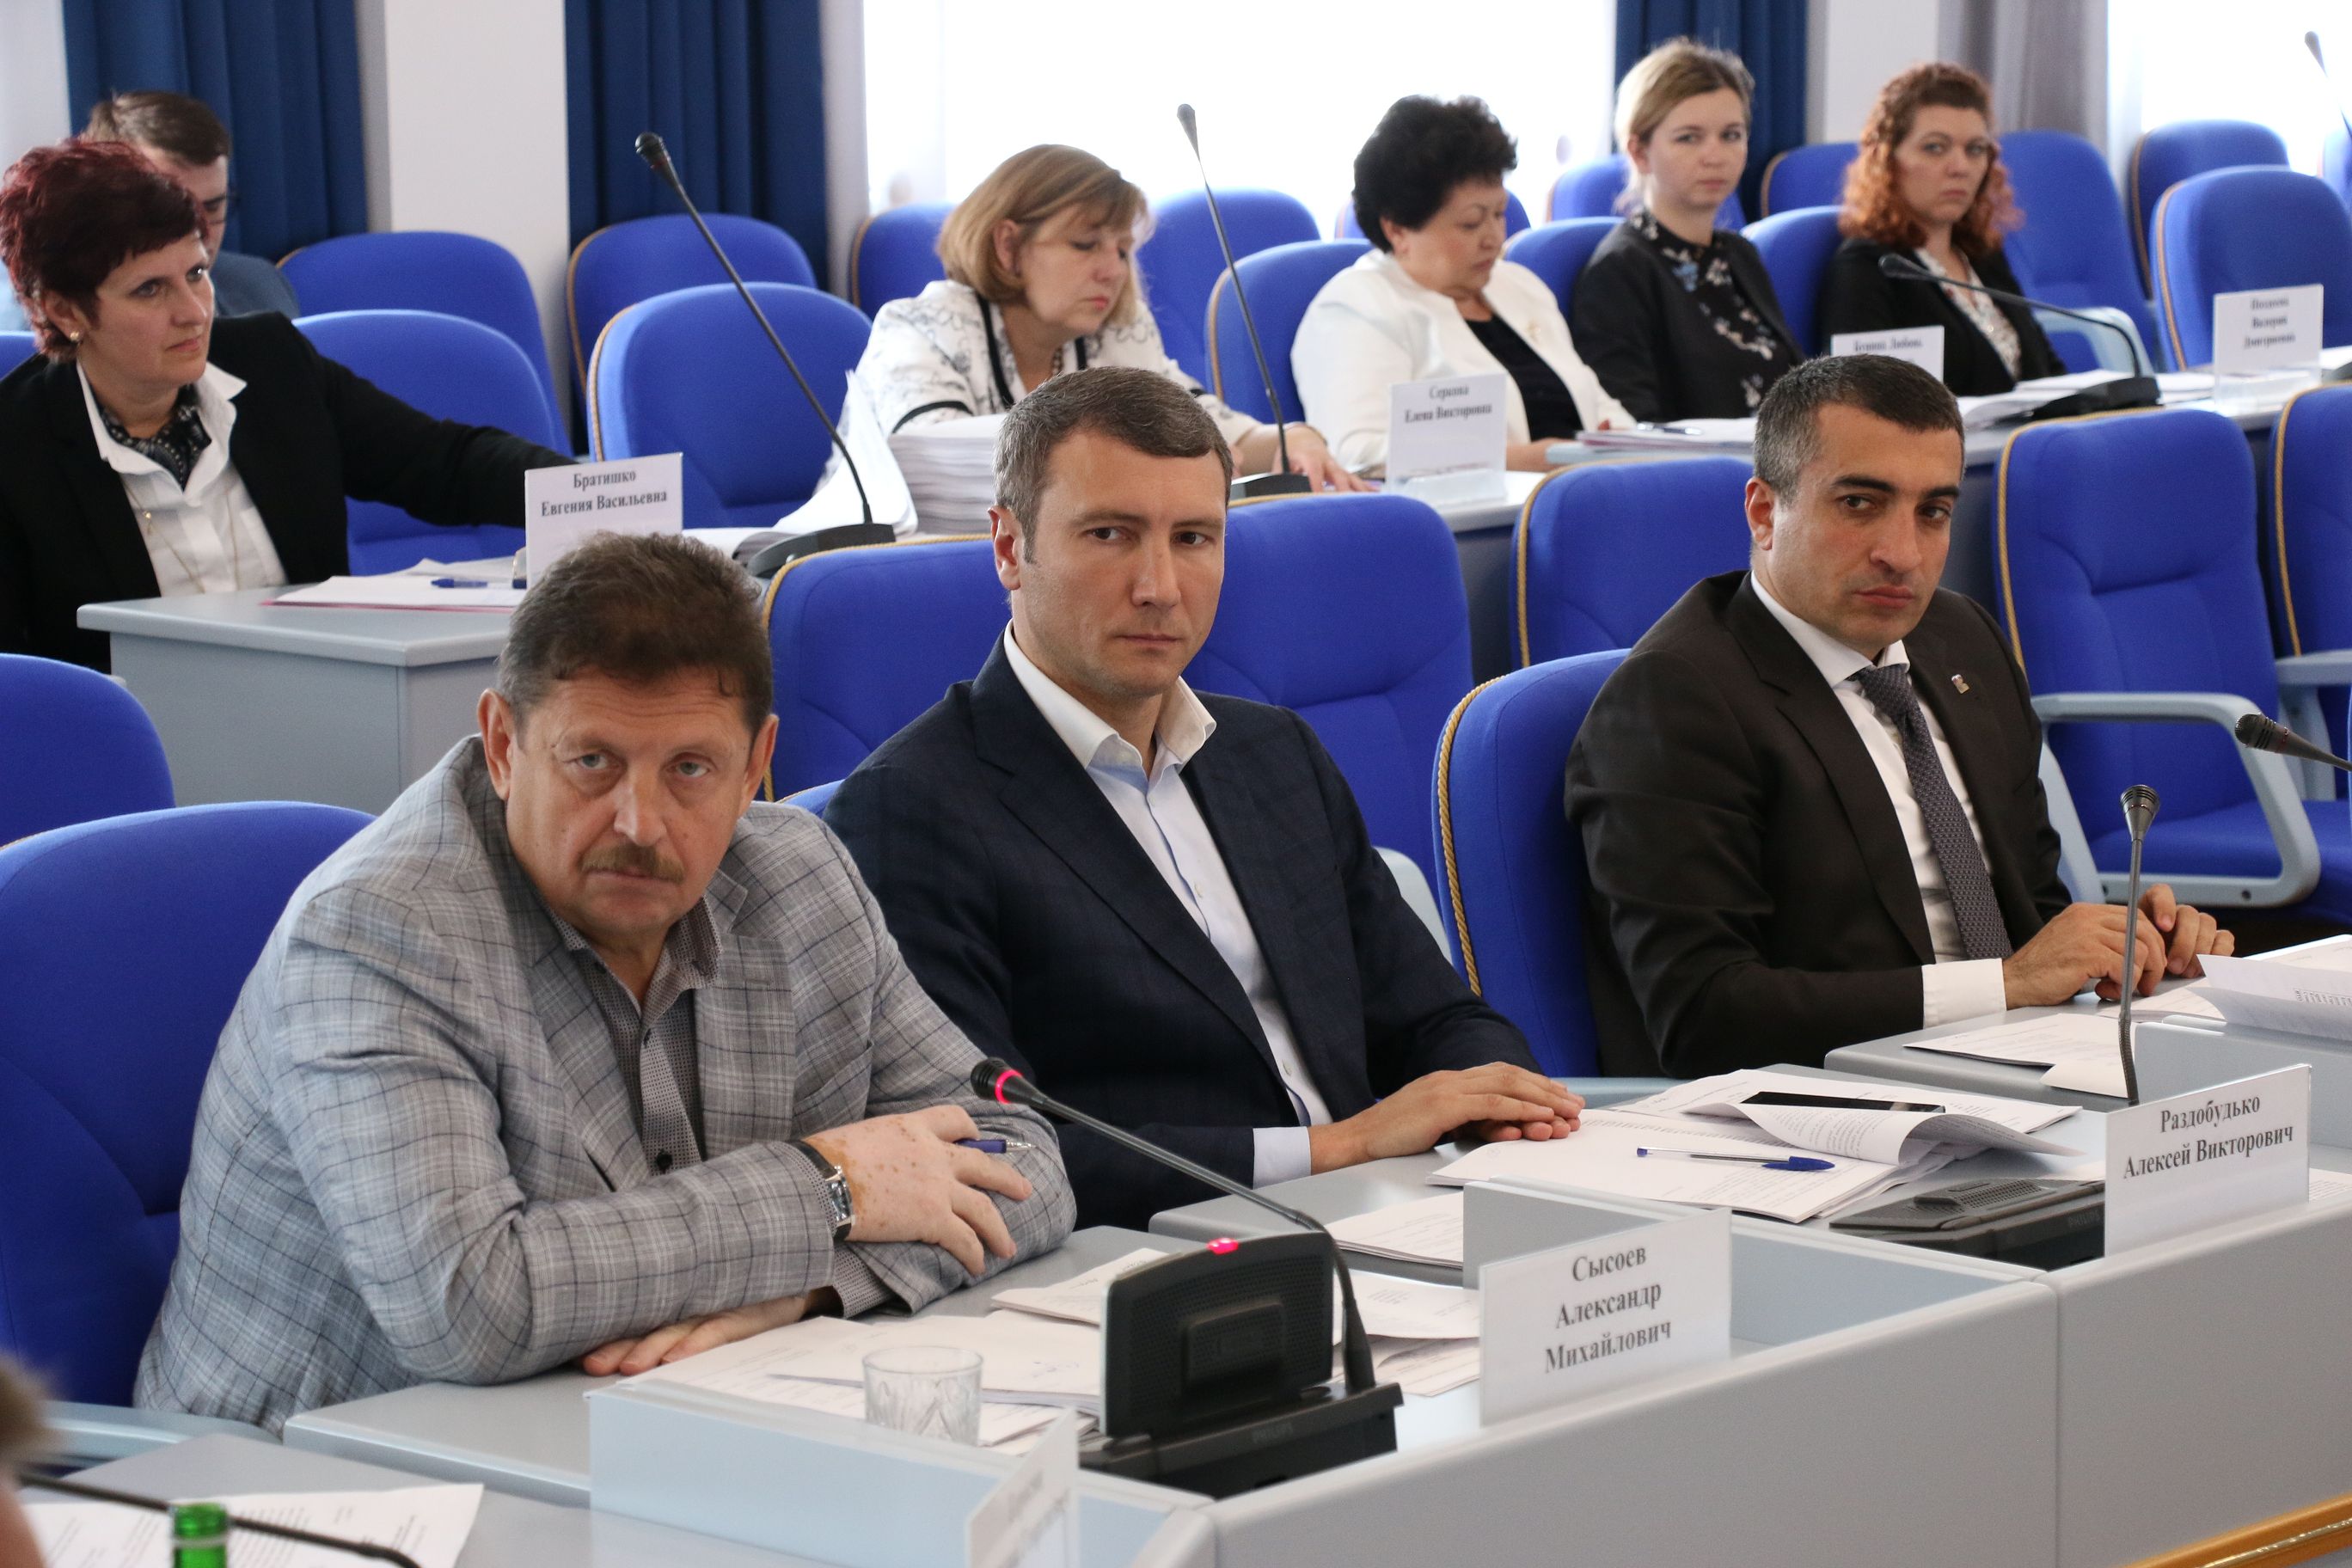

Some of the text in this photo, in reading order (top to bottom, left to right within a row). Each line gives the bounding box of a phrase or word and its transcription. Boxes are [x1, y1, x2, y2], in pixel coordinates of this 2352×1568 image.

[1405, 403, 1493, 424] Елена Викторовна
[573, 470, 636, 492] Братишко
[541, 491, 668, 517] Евгения Васильевна
[2159, 1094, 2261, 1134] Раздобудько
[2122, 1125, 2294, 1179] Алексей Викторович
[1571, 1246, 1647, 1283] Сысоев
[1554, 1283, 1663, 1329] Александр
[1545, 1320, 1672, 1374] Михайлович
